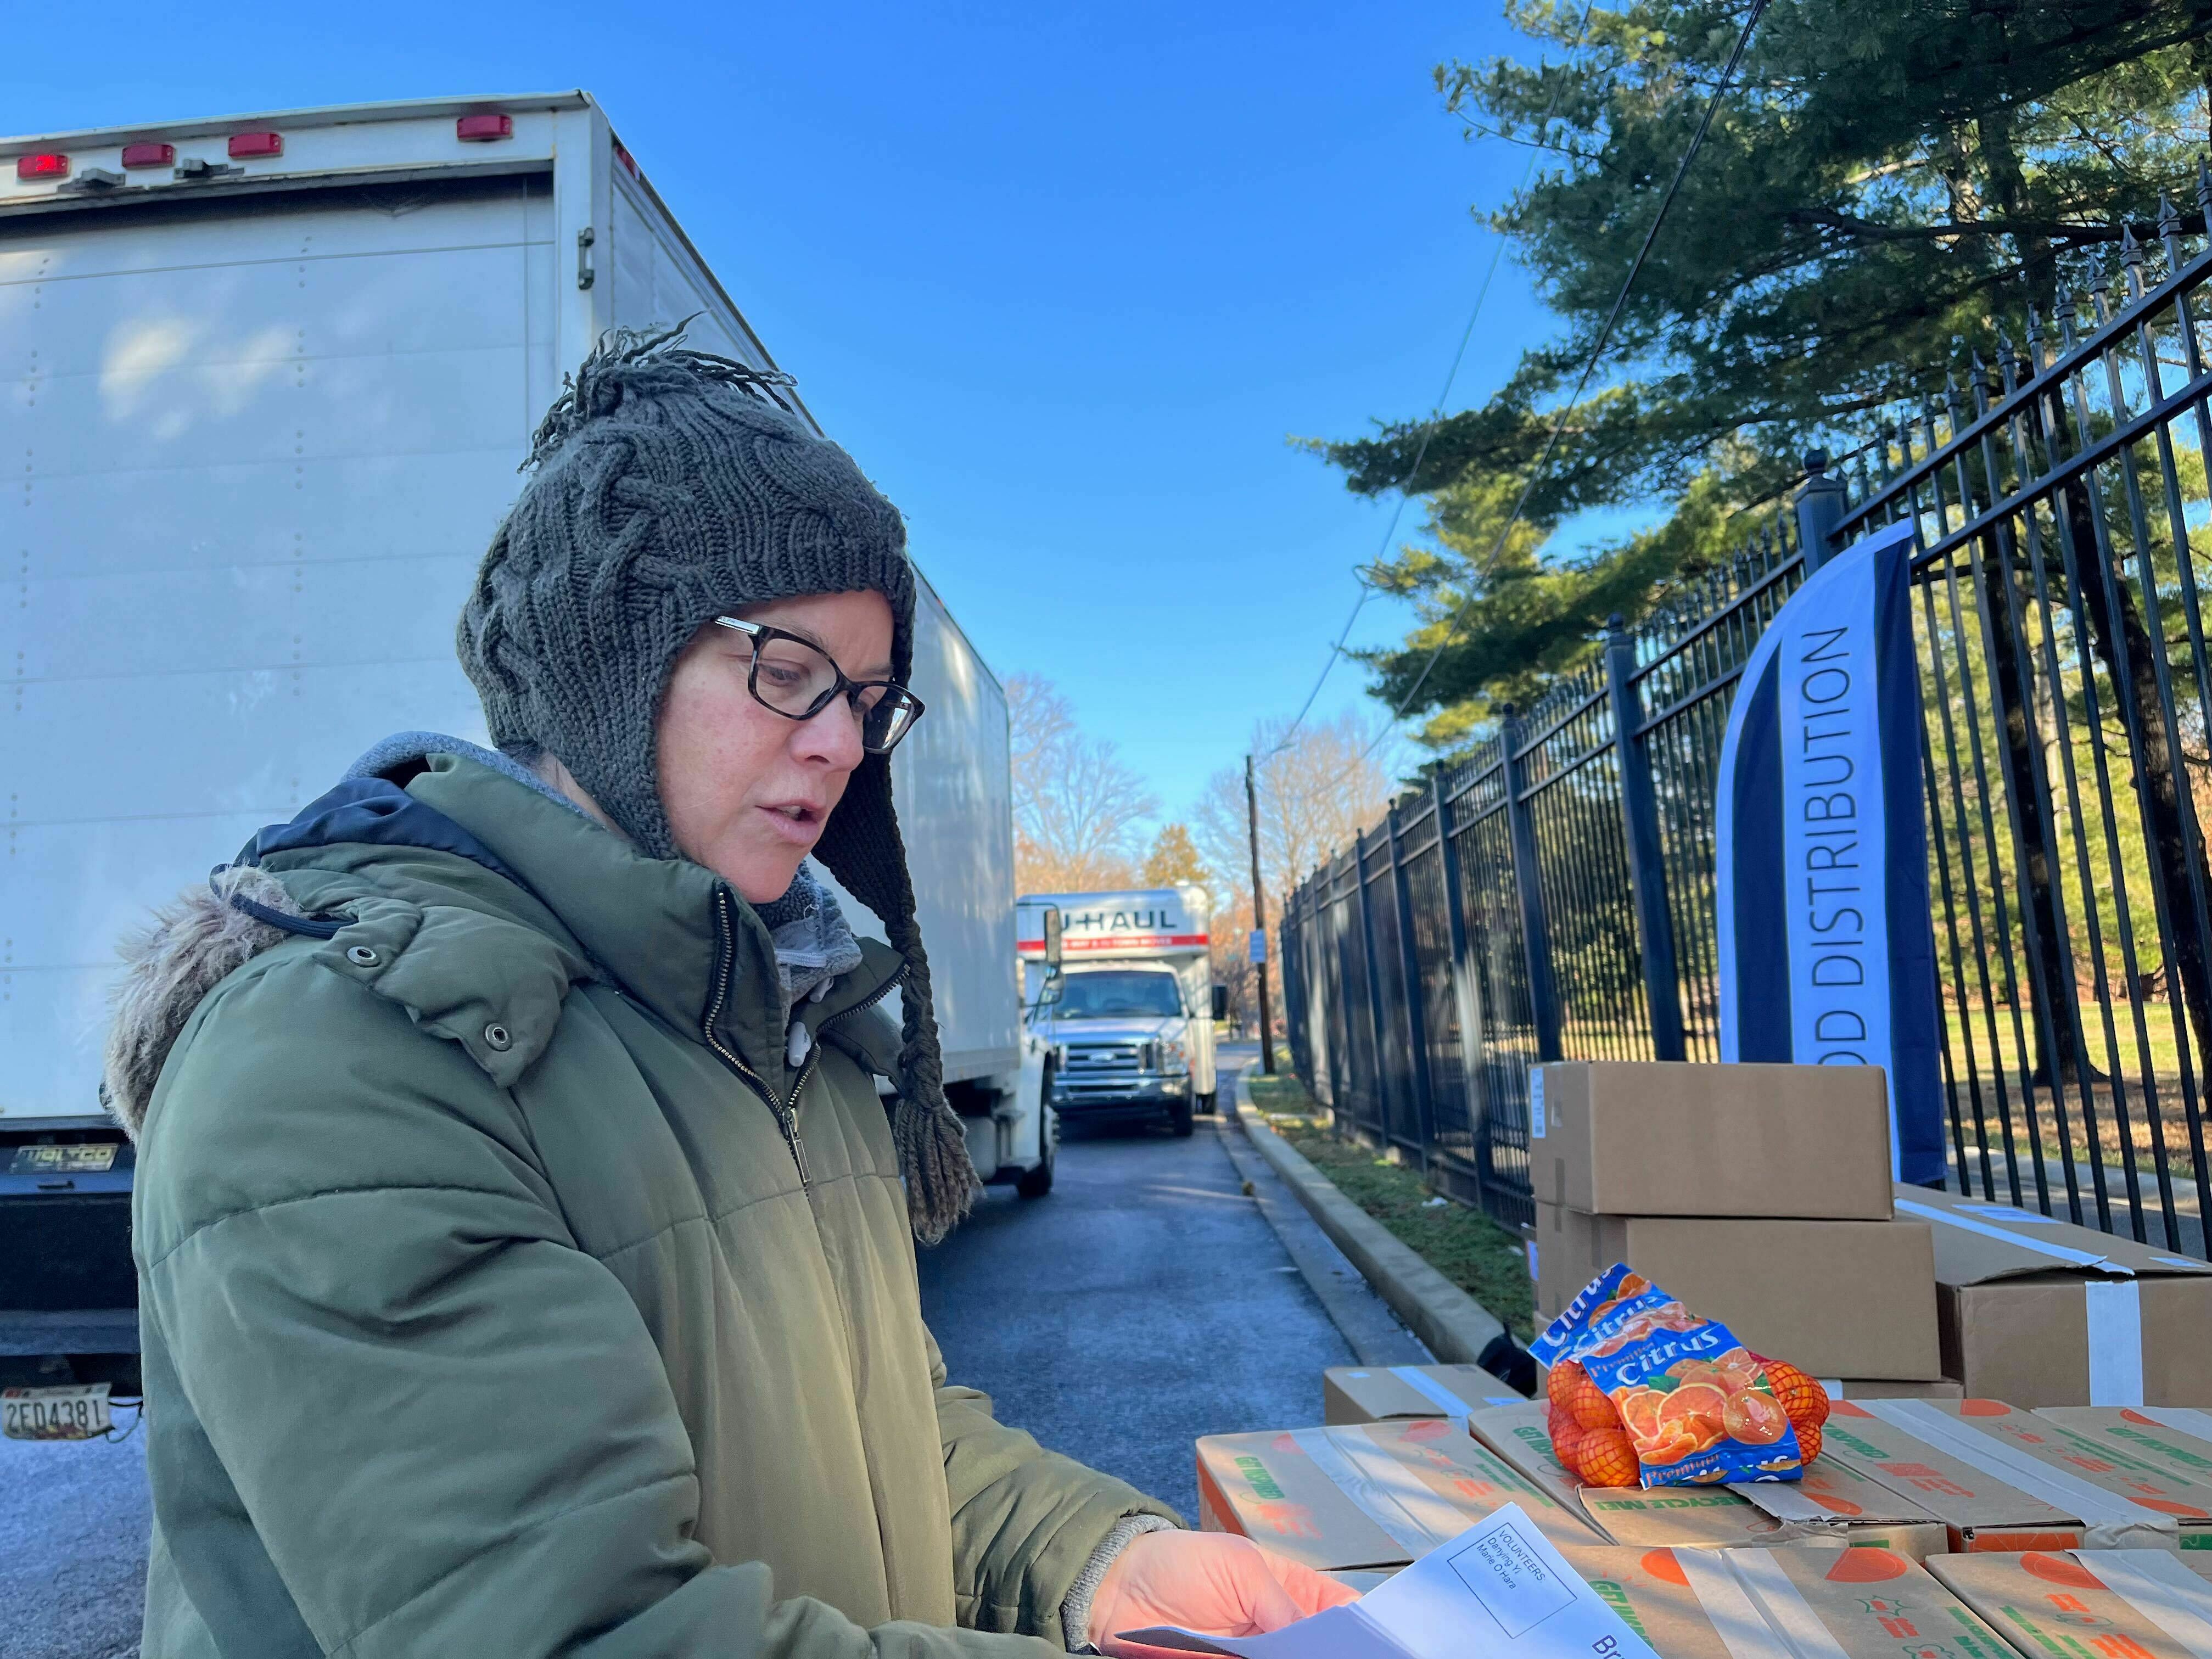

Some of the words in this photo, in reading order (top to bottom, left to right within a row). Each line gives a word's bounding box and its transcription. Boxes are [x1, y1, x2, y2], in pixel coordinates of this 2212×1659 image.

[1801, 626, 1865, 988] DISTRIBUTION
[1616, 1329, 1720, 1385] Citrus
[1646, 1454, 1720, 1487] Premium
[1476, 1544, 1495, 1565] Marie
[1487, 1537, 1514, 1567] Danying
[1513, 1564, 1522, 1574] Yi
[1592, 1635, 1625, 1659] Br
